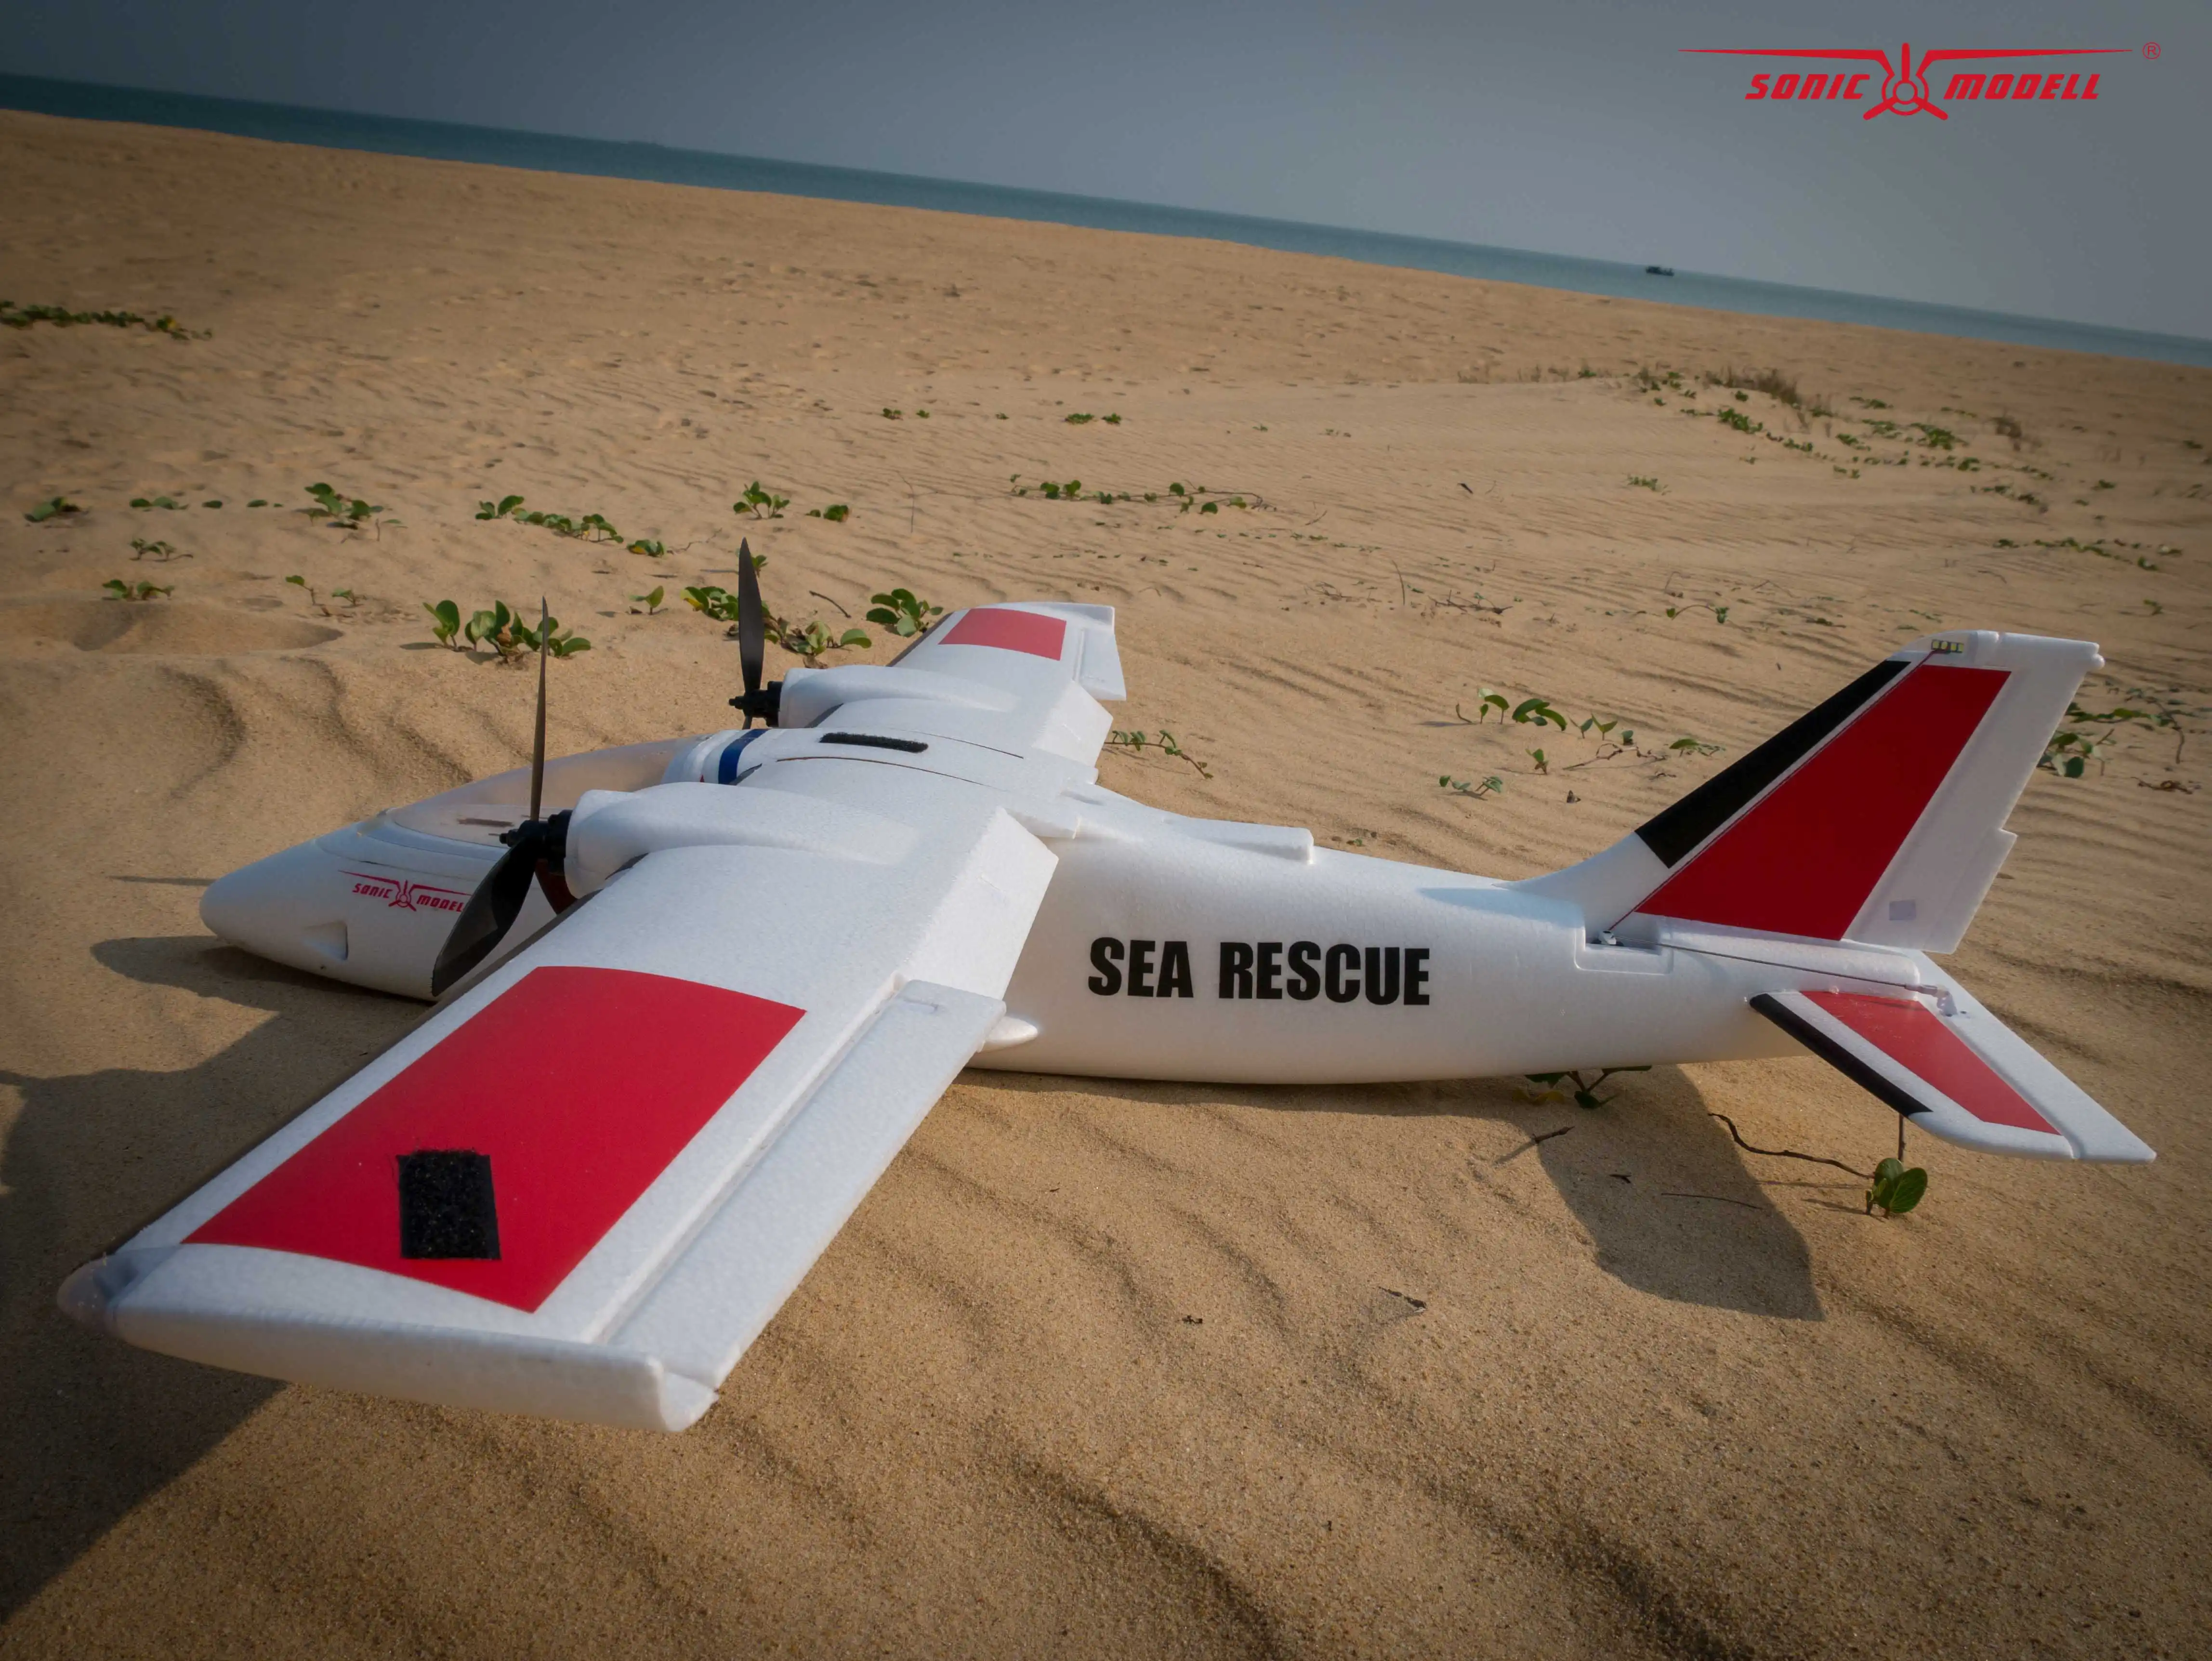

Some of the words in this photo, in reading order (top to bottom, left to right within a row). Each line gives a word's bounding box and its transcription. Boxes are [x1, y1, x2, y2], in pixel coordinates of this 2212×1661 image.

[353, 883, 393, 898] SONIC
[416, 894, 464, 912] MODEL
[1088, 936, 1194, 999] SEA
[1218, 940, 1430, 1006] RESCUE
